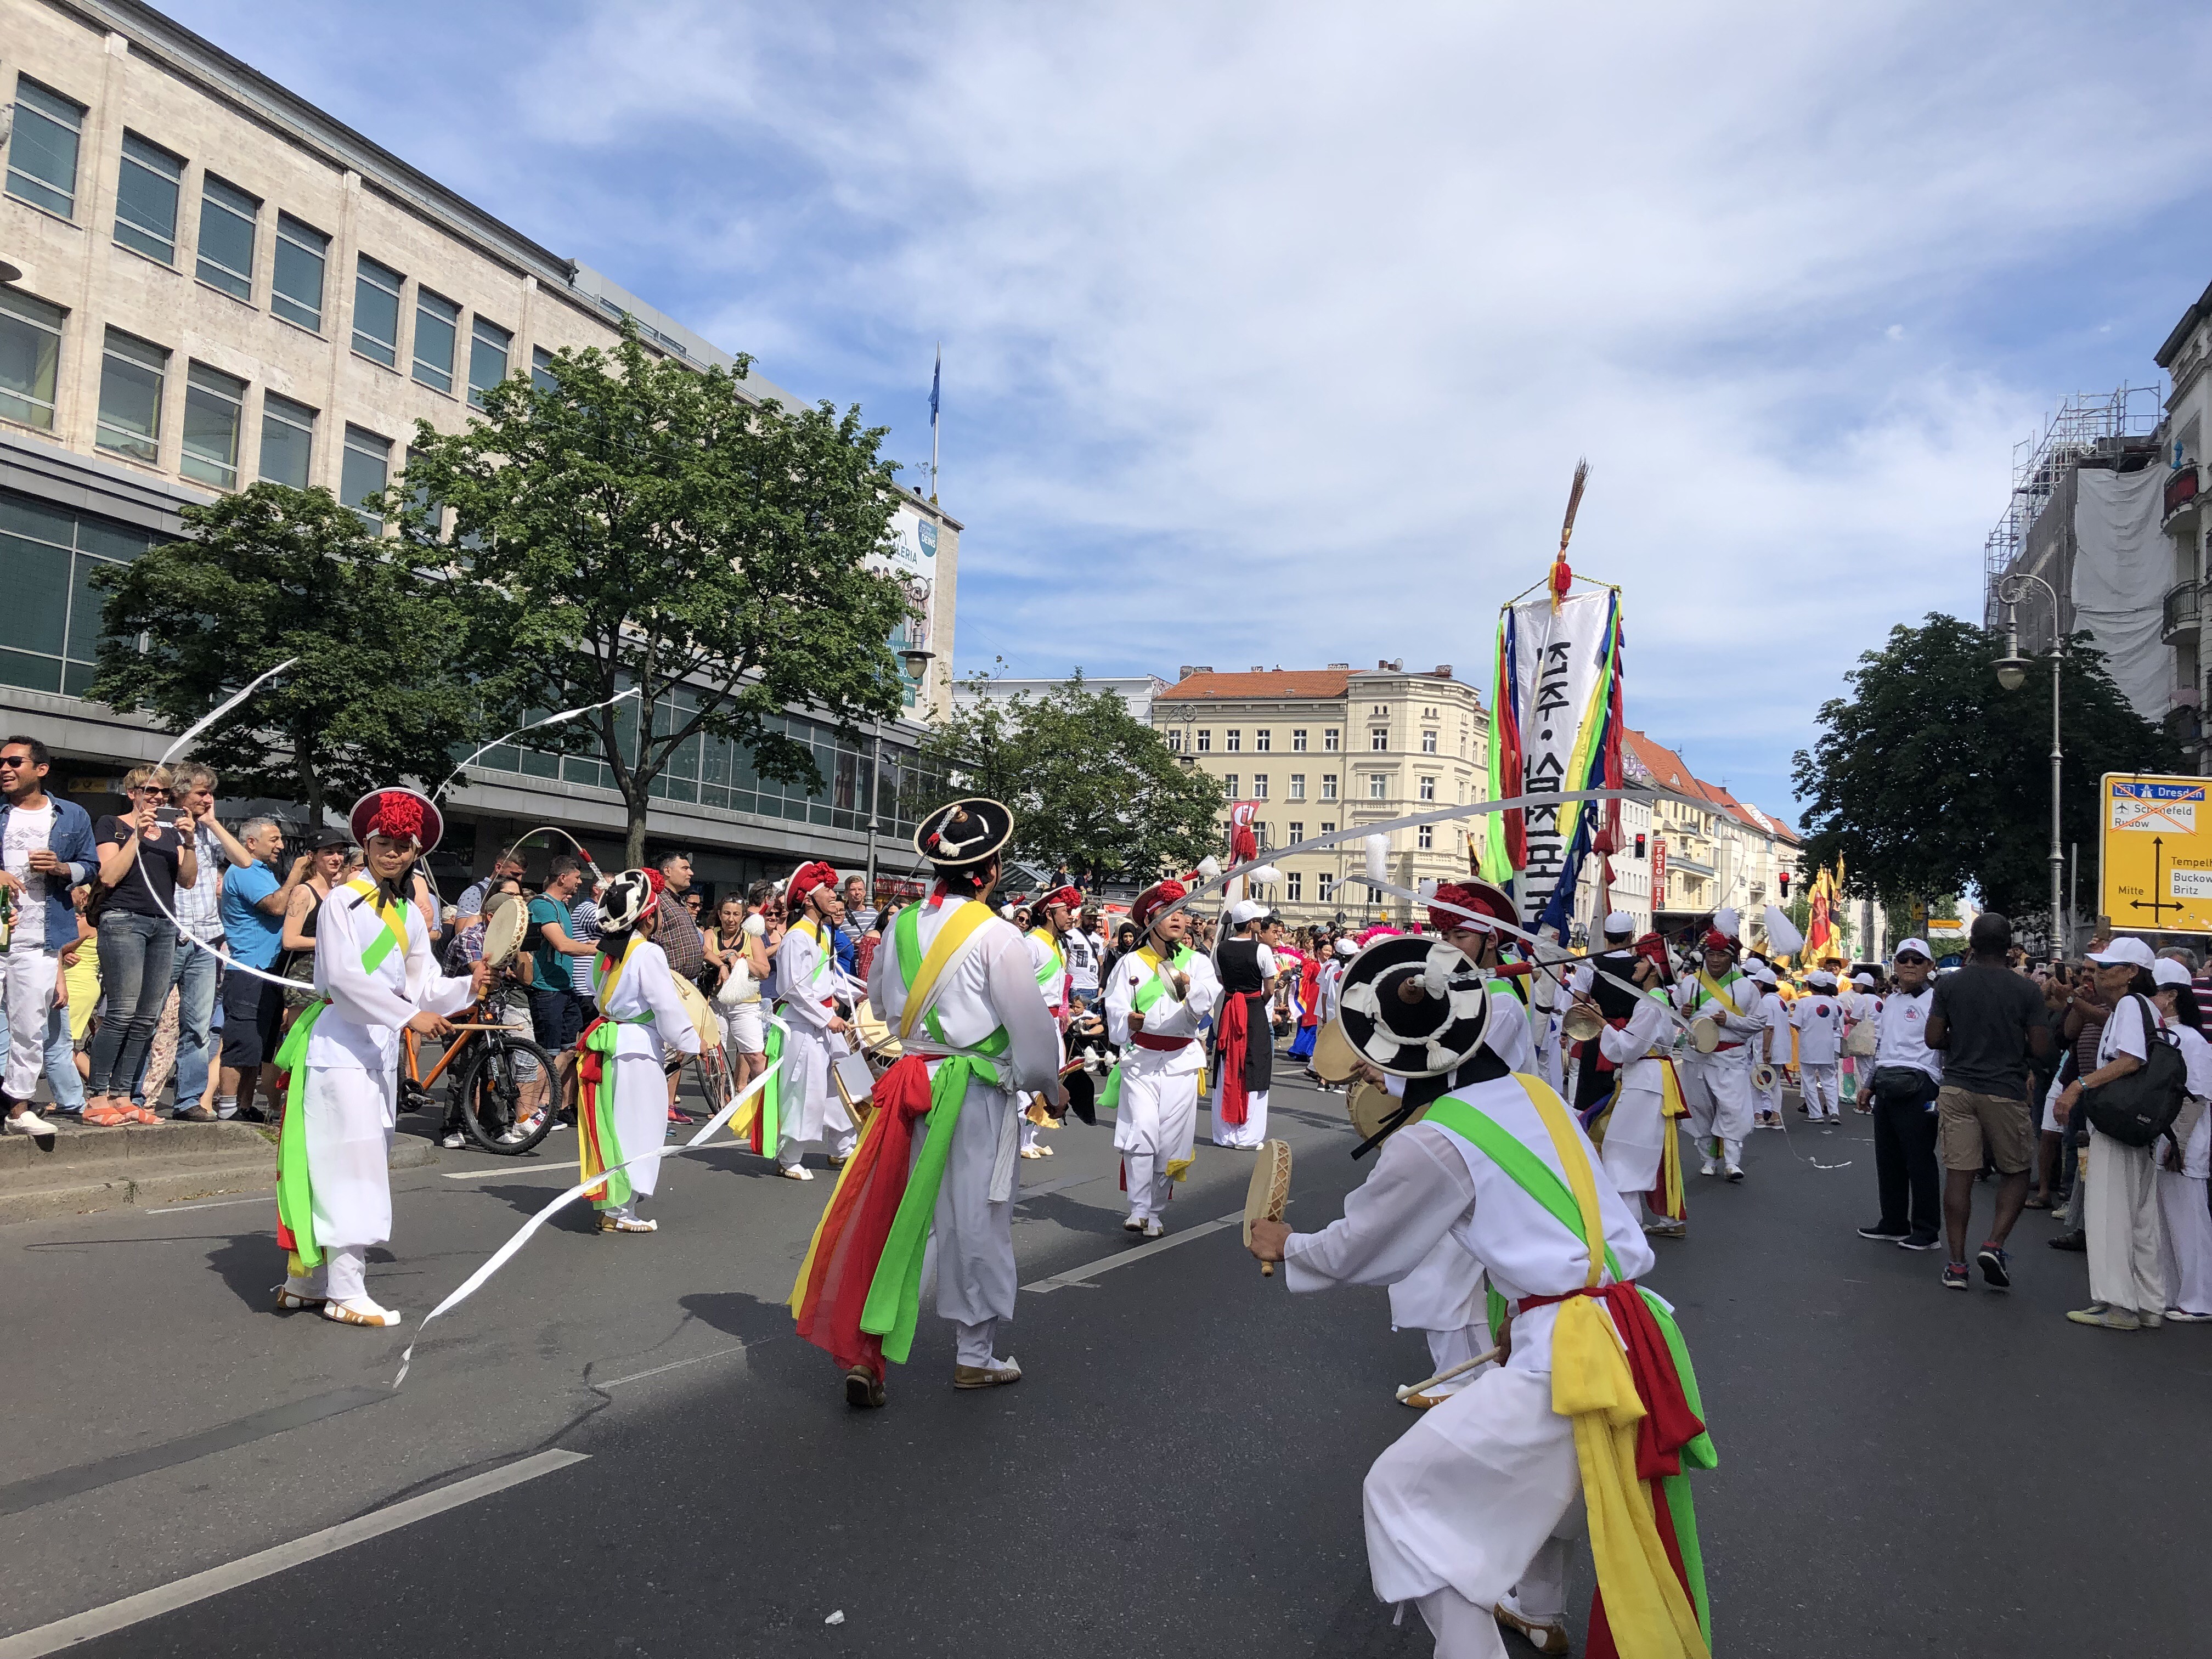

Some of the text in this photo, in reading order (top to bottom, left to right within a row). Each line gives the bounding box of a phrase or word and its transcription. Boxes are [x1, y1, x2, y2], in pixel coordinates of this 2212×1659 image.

[921, 533, 936, 549] DEINS
[2134, 804, 2192, 815] Schnefeld
[2118, 885, 2144, 895] Mitte
[2174, 885, 2198, 895] Britz
[1951, 957, 1958, 966] U
